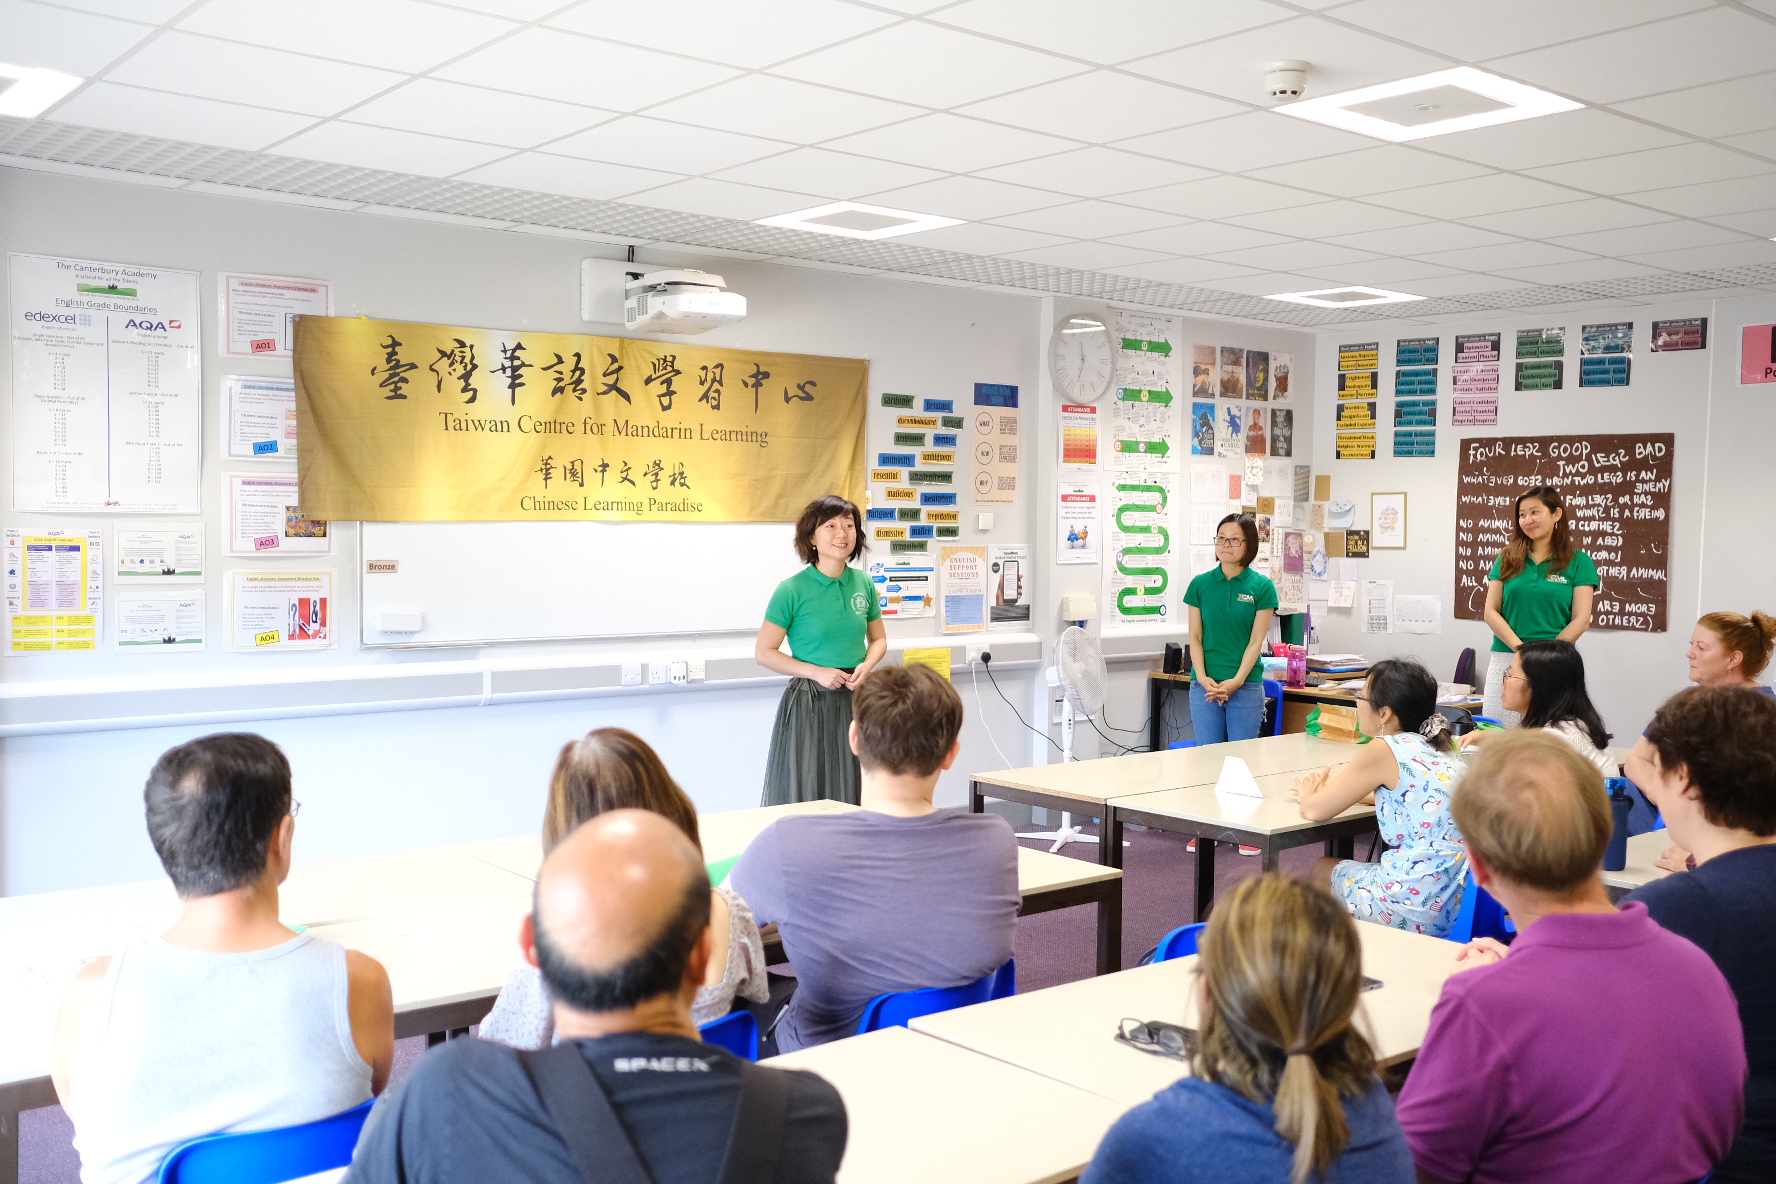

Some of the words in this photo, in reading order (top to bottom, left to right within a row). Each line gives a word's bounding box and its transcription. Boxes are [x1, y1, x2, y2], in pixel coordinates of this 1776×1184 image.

[56, 262, 71, 270] The
[74, 264, 118, 275] Canterbury
[121, 269, 157, 280] Academy
[56, 298, 85, 308] English
[87, 300, 111, 310] Grade
[113, 303, 157, 313] Boundaries
[25, 311, 76, 324] edexcel
[125, 319, 167, 332] AQA
[370, 335, 817, 414] 臺灣華語文學習中心
[884, 396, 911, 406] sardonic
[438, 412, 510, 433] Taiwan
[518, 414, 575, 435] Centre
[582, 416, 606, 436] for
[611, 418, 693, 440] Mandarin
[699, 423, 768, 447] Learning
[923, 453, 952, 462] ambiguous
[1469, 441, 1505, 464] FOUR
[1636, 442, 1666, 458] BAD
[882, 456, 910, 465] animosity
[1557, 461, 1589, 476] TWO
[1592, 449, 1629, 468] LEGS
[534, 455, 691, 491] 華園中文學校
[873, 471, 898, 479] resentful
[1463, 475, 1513, 486] WHATEVER
[1518, 475, 1542, 486] GOES
[1546, 475, 1572, 486] UPON
[1574, 475, 1594, 485] TWO
[1598, 472, 1623, 486] LEGS
[1627, 471, 1637, 480] IS
[1640, 469, 1656, 480] AN
[1635, 478, 1670, 493] ENEMY
[520, 495, 578, 511] Chinese
[582, 497, 644, 515] Learning
[648, 498, 703, 513] Paradise
[1566, 495, 1586, 507] FOUR
[1619, 495, 1631, 505] OR
[1634, 494, 1653, 505] HAS
[868, 510, 893, 519] fatigued
[900, 510, 918, 519] jovial
[927, 513, 956, 521] trepidation
[1576, 507, 1606, 520] WINGS
[1611, 508, 1619, 518] IS
[1624, 508, 1631, 518] A
[1634, 507, 1665, 520] FREIND
[1460, 520, 1473, 528] NO
[1478, 519, 1513, 529] ANIMAL
[876, 529, 904, 537] dismissive
[1460, 532, 1472, 542] NO
[1478, 532, 1509, 545] ANIMAL
[260, 539, 274, 547] AO3
[1459, 546, 1472, 556] NO
[369, 563, 395, 571] Bronze
[1460, 560, 1474, 570] NO
[1597, 566, 1627, 580] OTHER
[1630, 567, 1666, 581] ANIMAL
[1461, 575, 1478, 587] ALL
[1597, 600, 1619, 612] ARE
[1626, 603, 1655, 615] MORE
[260, 634, 275, 642] AO4
[614, 1055, 720, 1072] SPACEX
